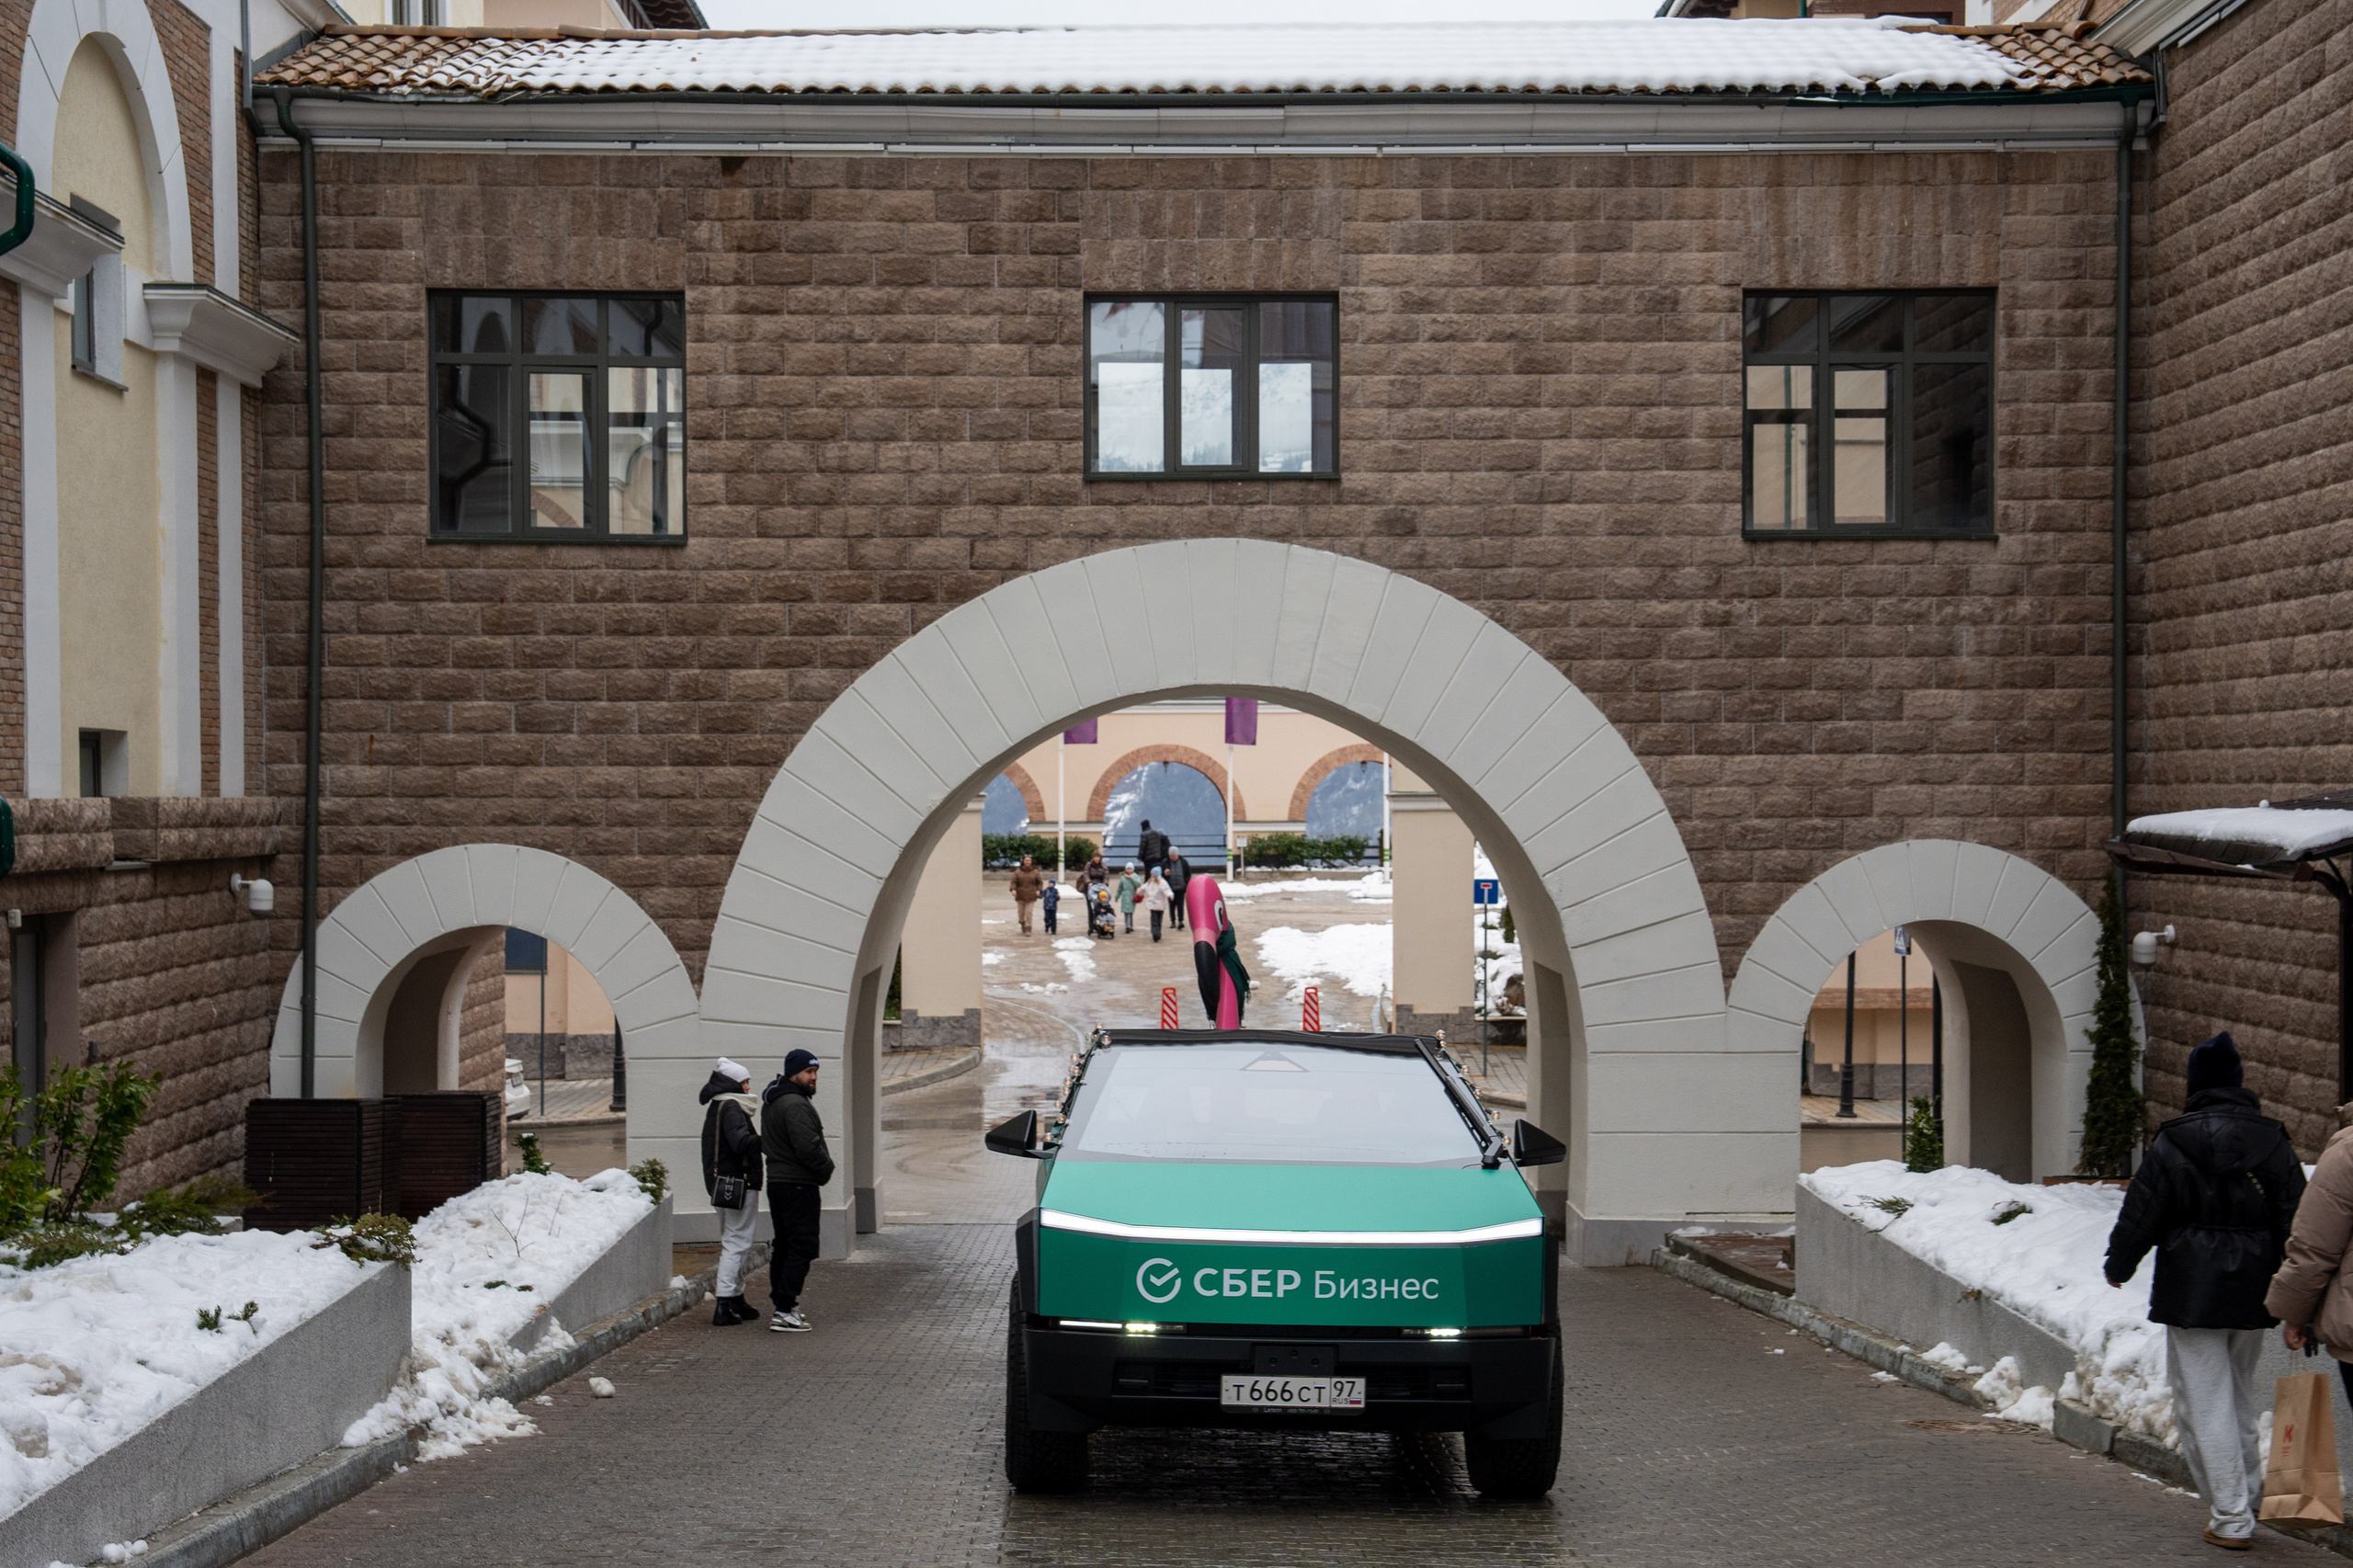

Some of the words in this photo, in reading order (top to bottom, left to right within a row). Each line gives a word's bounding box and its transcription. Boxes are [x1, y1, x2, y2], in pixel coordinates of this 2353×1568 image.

[1194, 1268, 1302, 1297] СБЕР
[1314, 1270, 1439, 1300] Бизнес
[1333, 1381, 1356, 1397] 97
